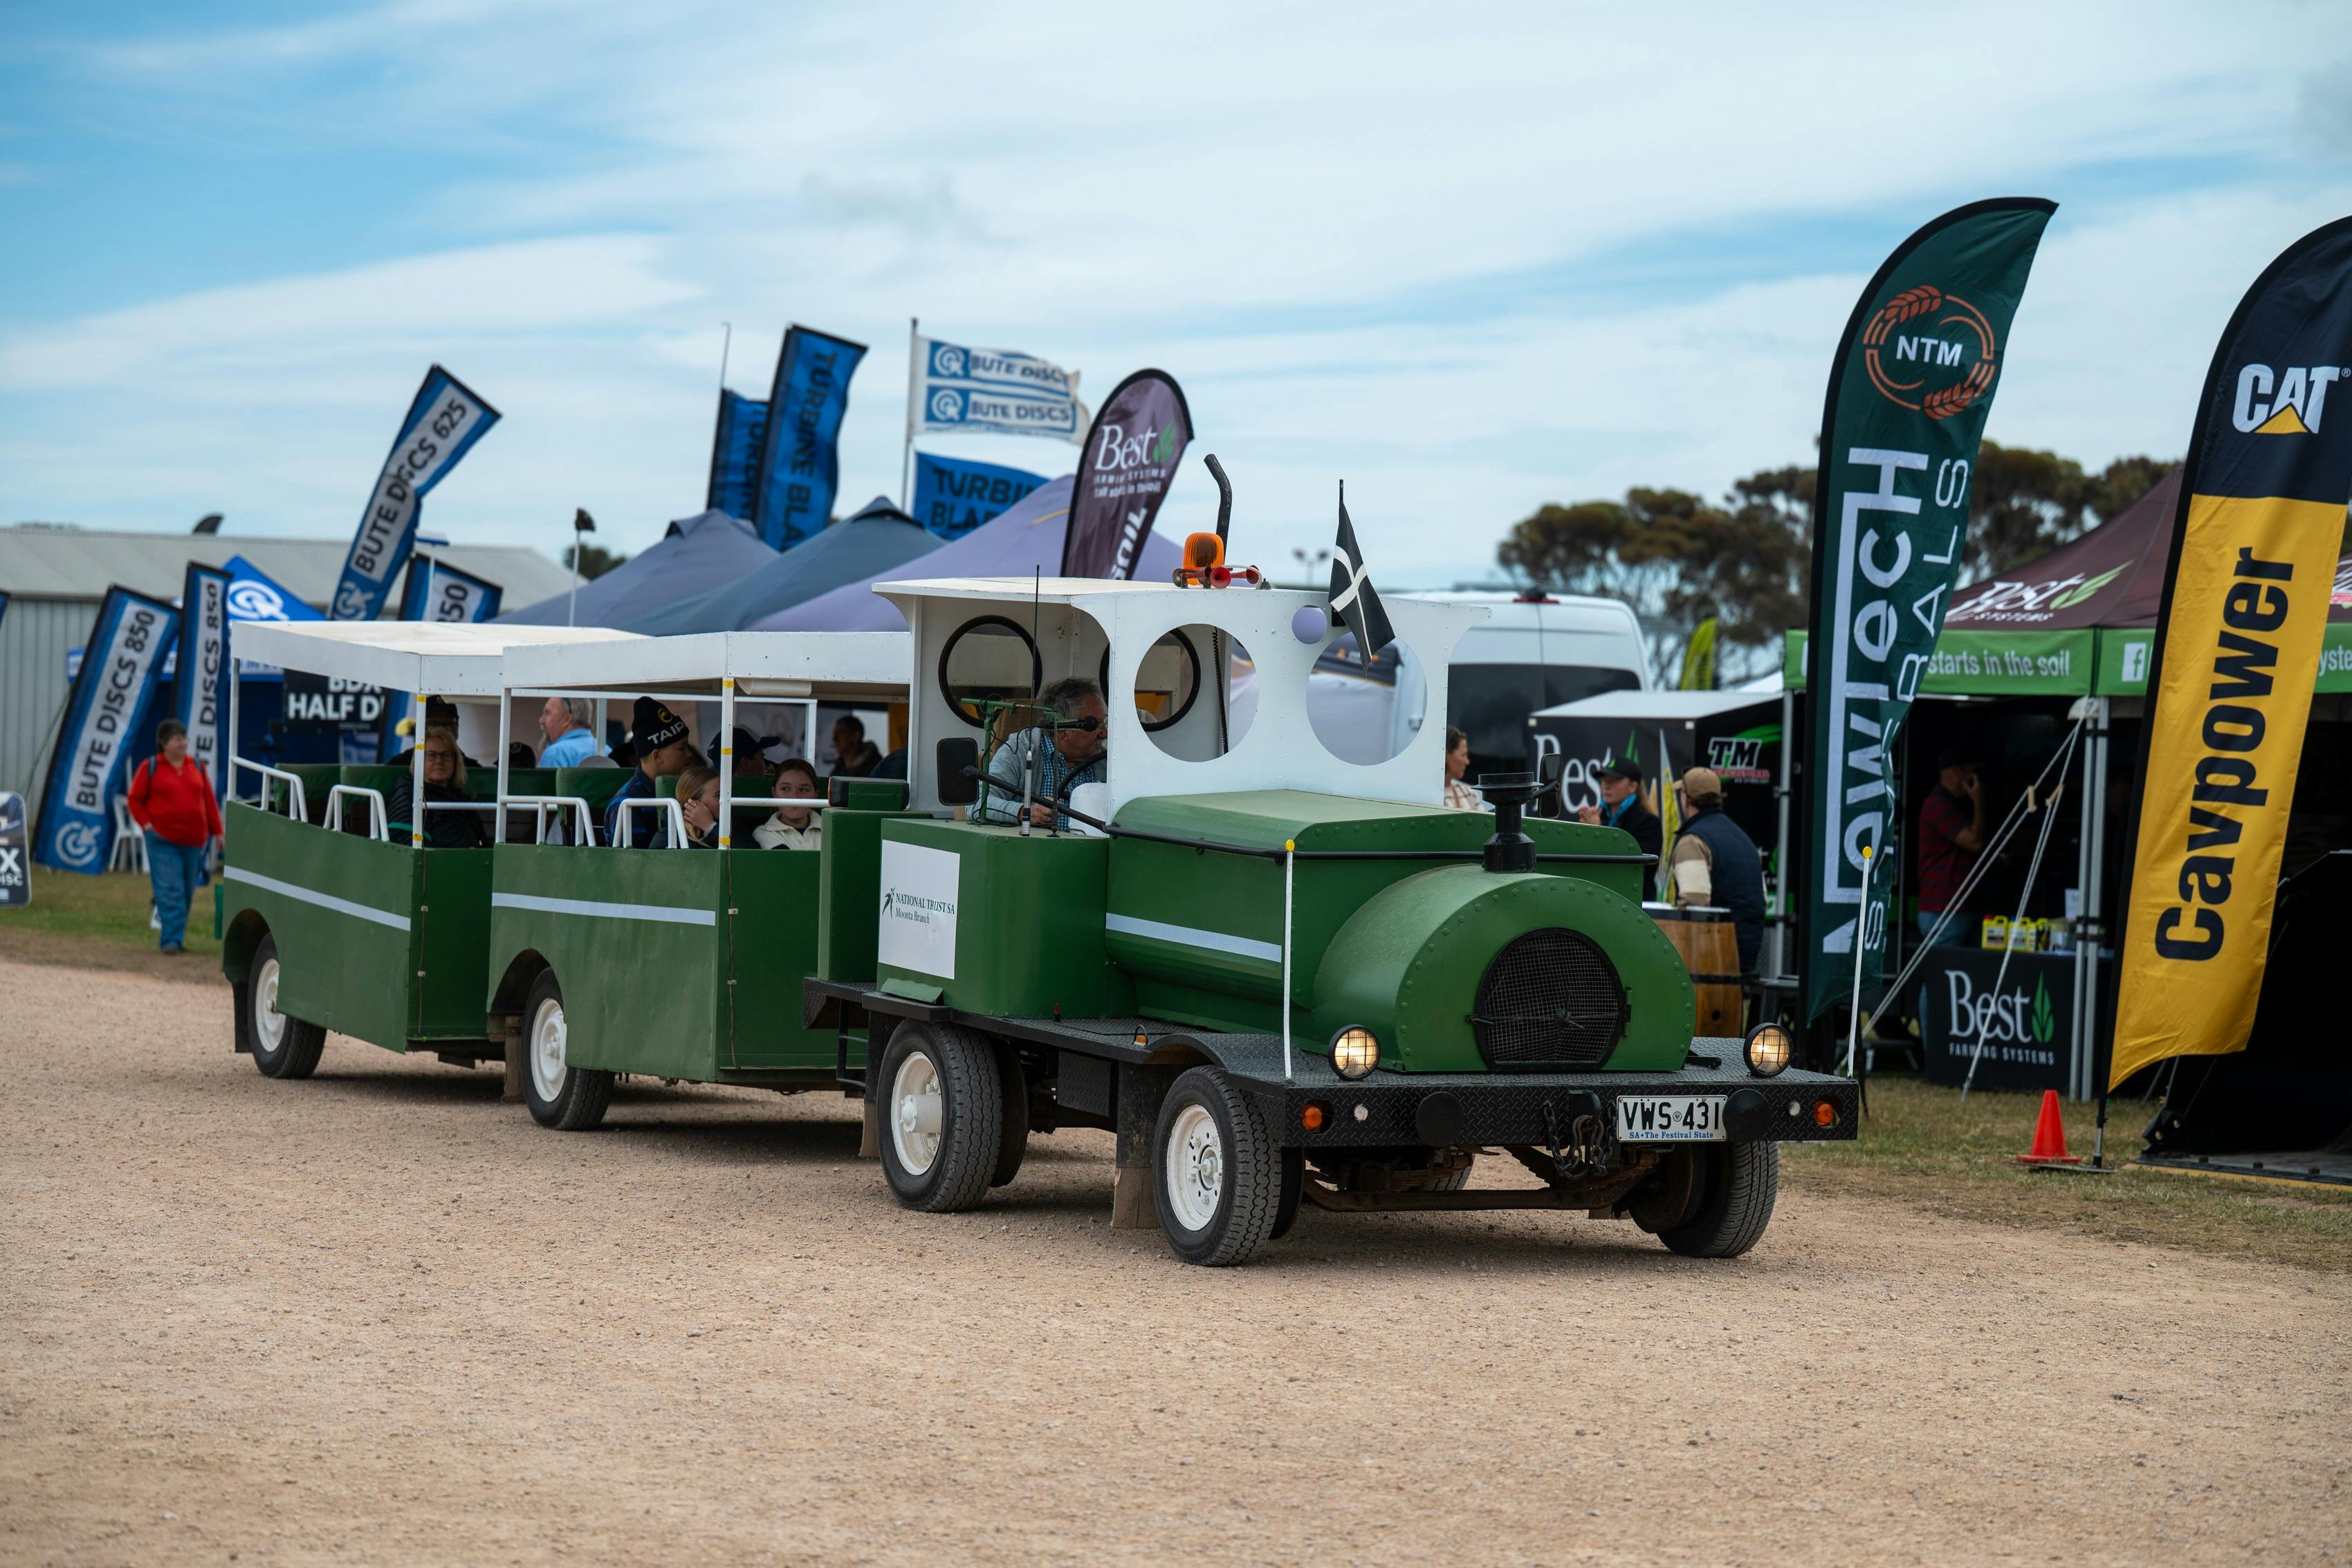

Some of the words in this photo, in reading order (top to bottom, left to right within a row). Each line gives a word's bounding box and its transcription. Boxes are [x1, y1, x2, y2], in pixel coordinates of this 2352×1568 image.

[971, 355, 1015, 374] BUTE
[1896, 335, 1963, 367] NTM
[791, 351, 838, 477] TURBINE
[970, 400, 1011, 419] BUTE
[1015, 405, 1070, 423] DISCS
[2232, 364, 2340, 434] CAT
[1094, 424, 1158, 470] Best
[354, 504, 398, 573] BUTE
[432, 398, 468, 441] 625
[780, 484, 812, 552] BLA
[205, 581, 218, 630] 850
[437, 582, 469, 621] 50
[1927, 649, 1981, 675] starts
[1983, 648, 2003, 676] in
[2005, 649, 2034, 676] the
[2037, 649, 2070, 676] soil
[2318, 644, 2352, 677] yste
[199, 638, 220, 726] DISCS
[76, 738, 111, 808] BUTE
[97, 654, 138, 735] DISCS
[125, 609, 156, 654] 850
[287, 692, 355, 720] HALF
[1708, 737, 1763, 770] TM
[2154, 546, 2295, 961] Cavpower
[895, 907, 913, 921] Moonta
[914, 910, 930, 924] Branch
[896, 892, 926, 909] NATIONAL
[926, 898, 947, 913] TRUST
[947, 903, 955, 914] SA
[1945, 969, 2032, 1044] Best
[1949, 1042, 1998, 1060] FARMNG
[2002, 1046, 2055, 1066] SYSTEMS
[1623, 1101, 1672, 1130] VWS
[1682, 1101, 1720, 1130] 431
